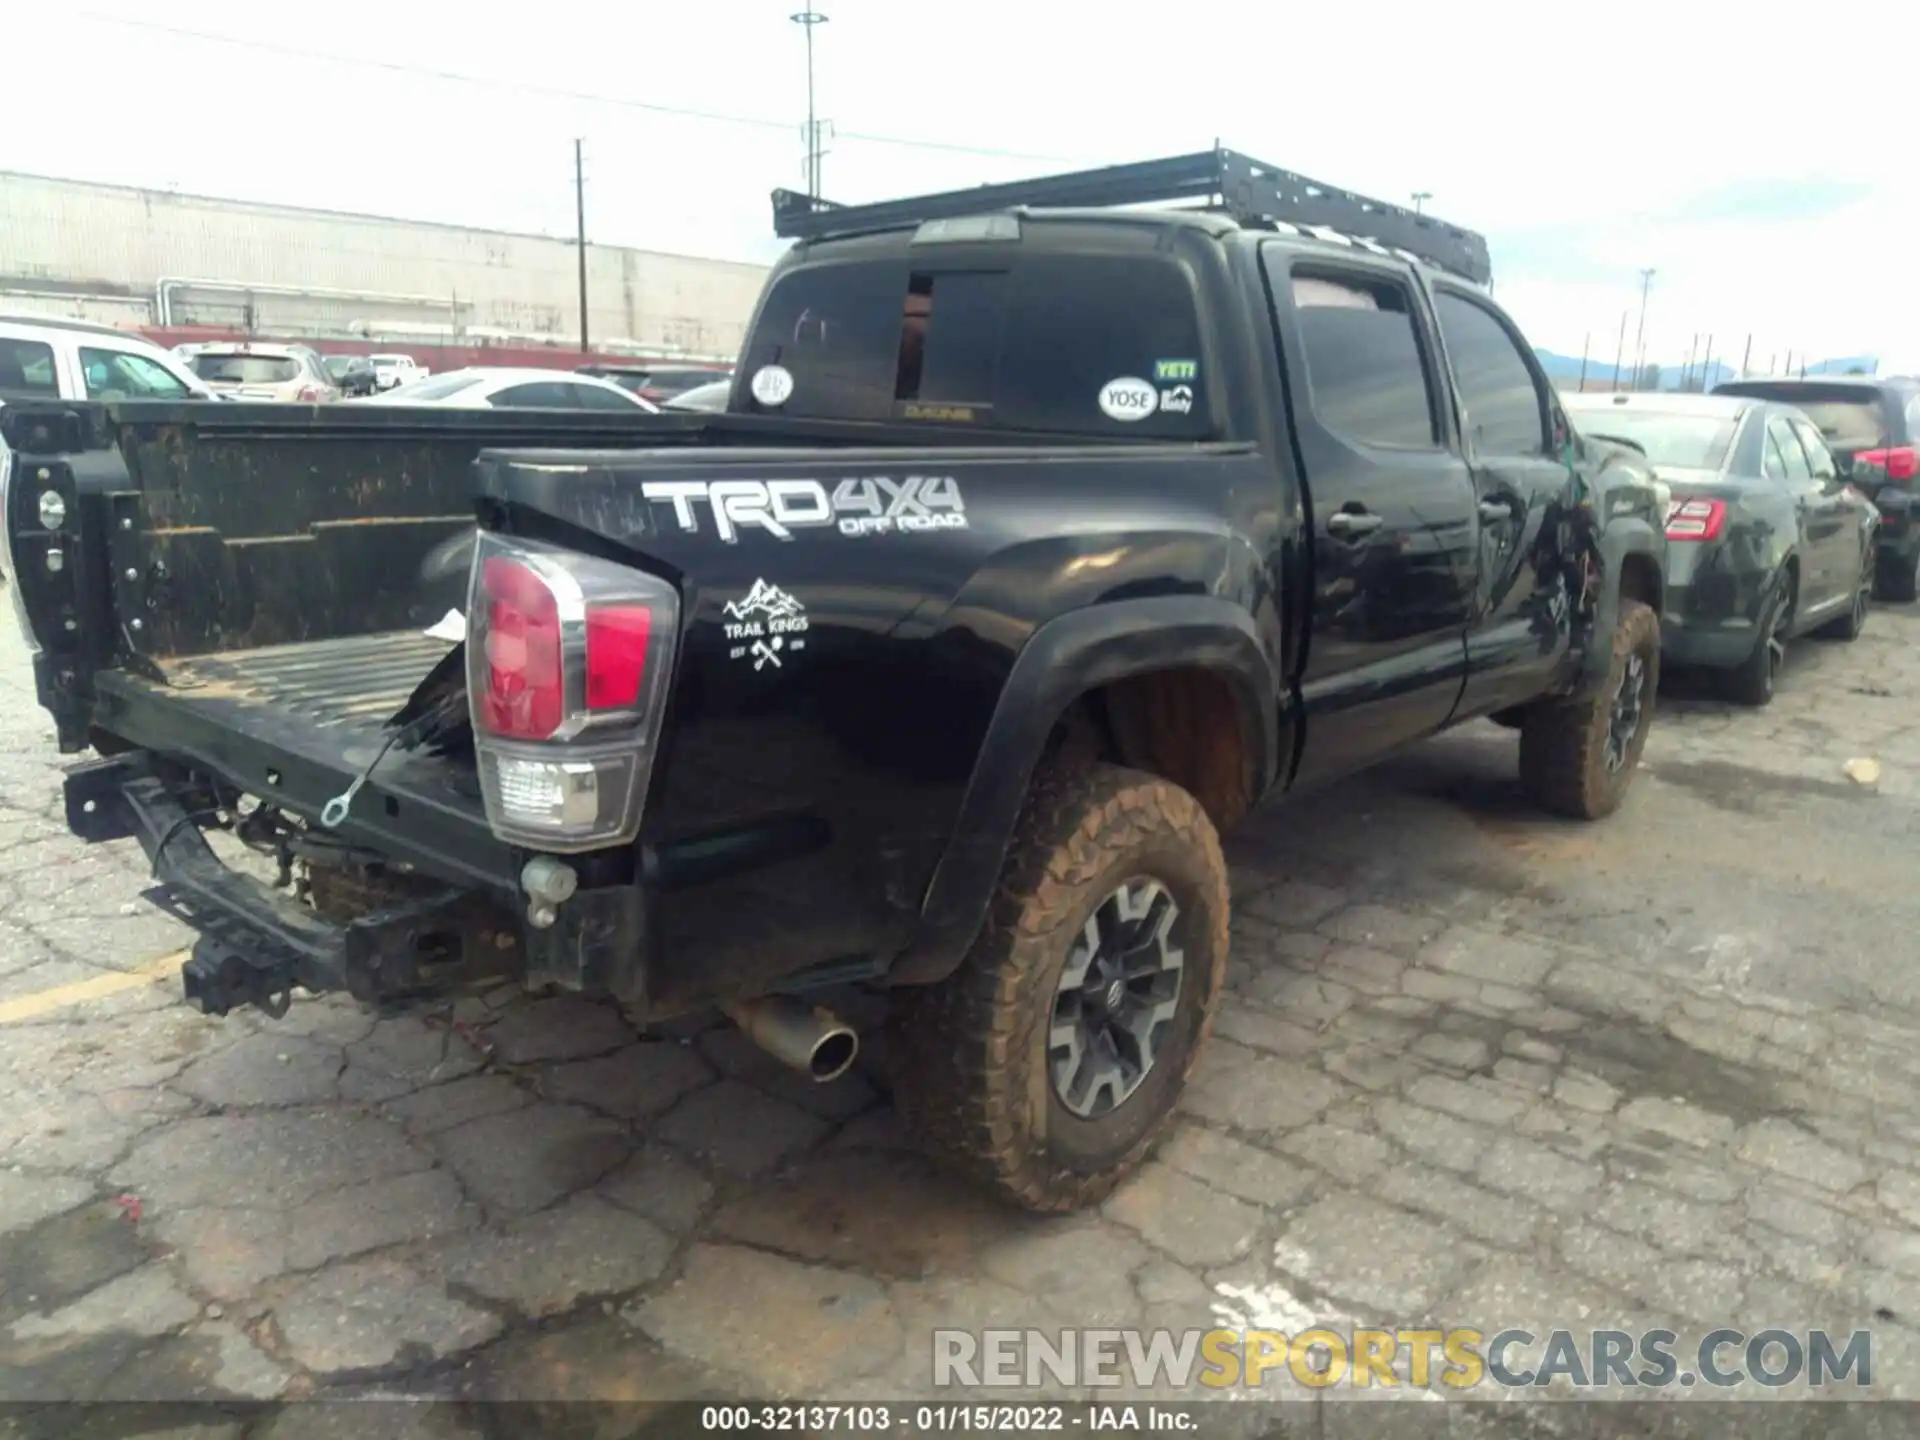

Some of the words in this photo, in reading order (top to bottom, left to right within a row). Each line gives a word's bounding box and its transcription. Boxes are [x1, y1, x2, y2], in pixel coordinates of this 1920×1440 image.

[1156, 361, 1197, 379] YETI
[1107, 389, 1150, 408] YOSE
[641, 479, 836, 544] TRD
[838, 517, 892, 537] OFF
[897, 512, 970, 534] ROAD
[724, 622, 766, 639] TRAIL
[768, 616, 809, 634] KINGS
